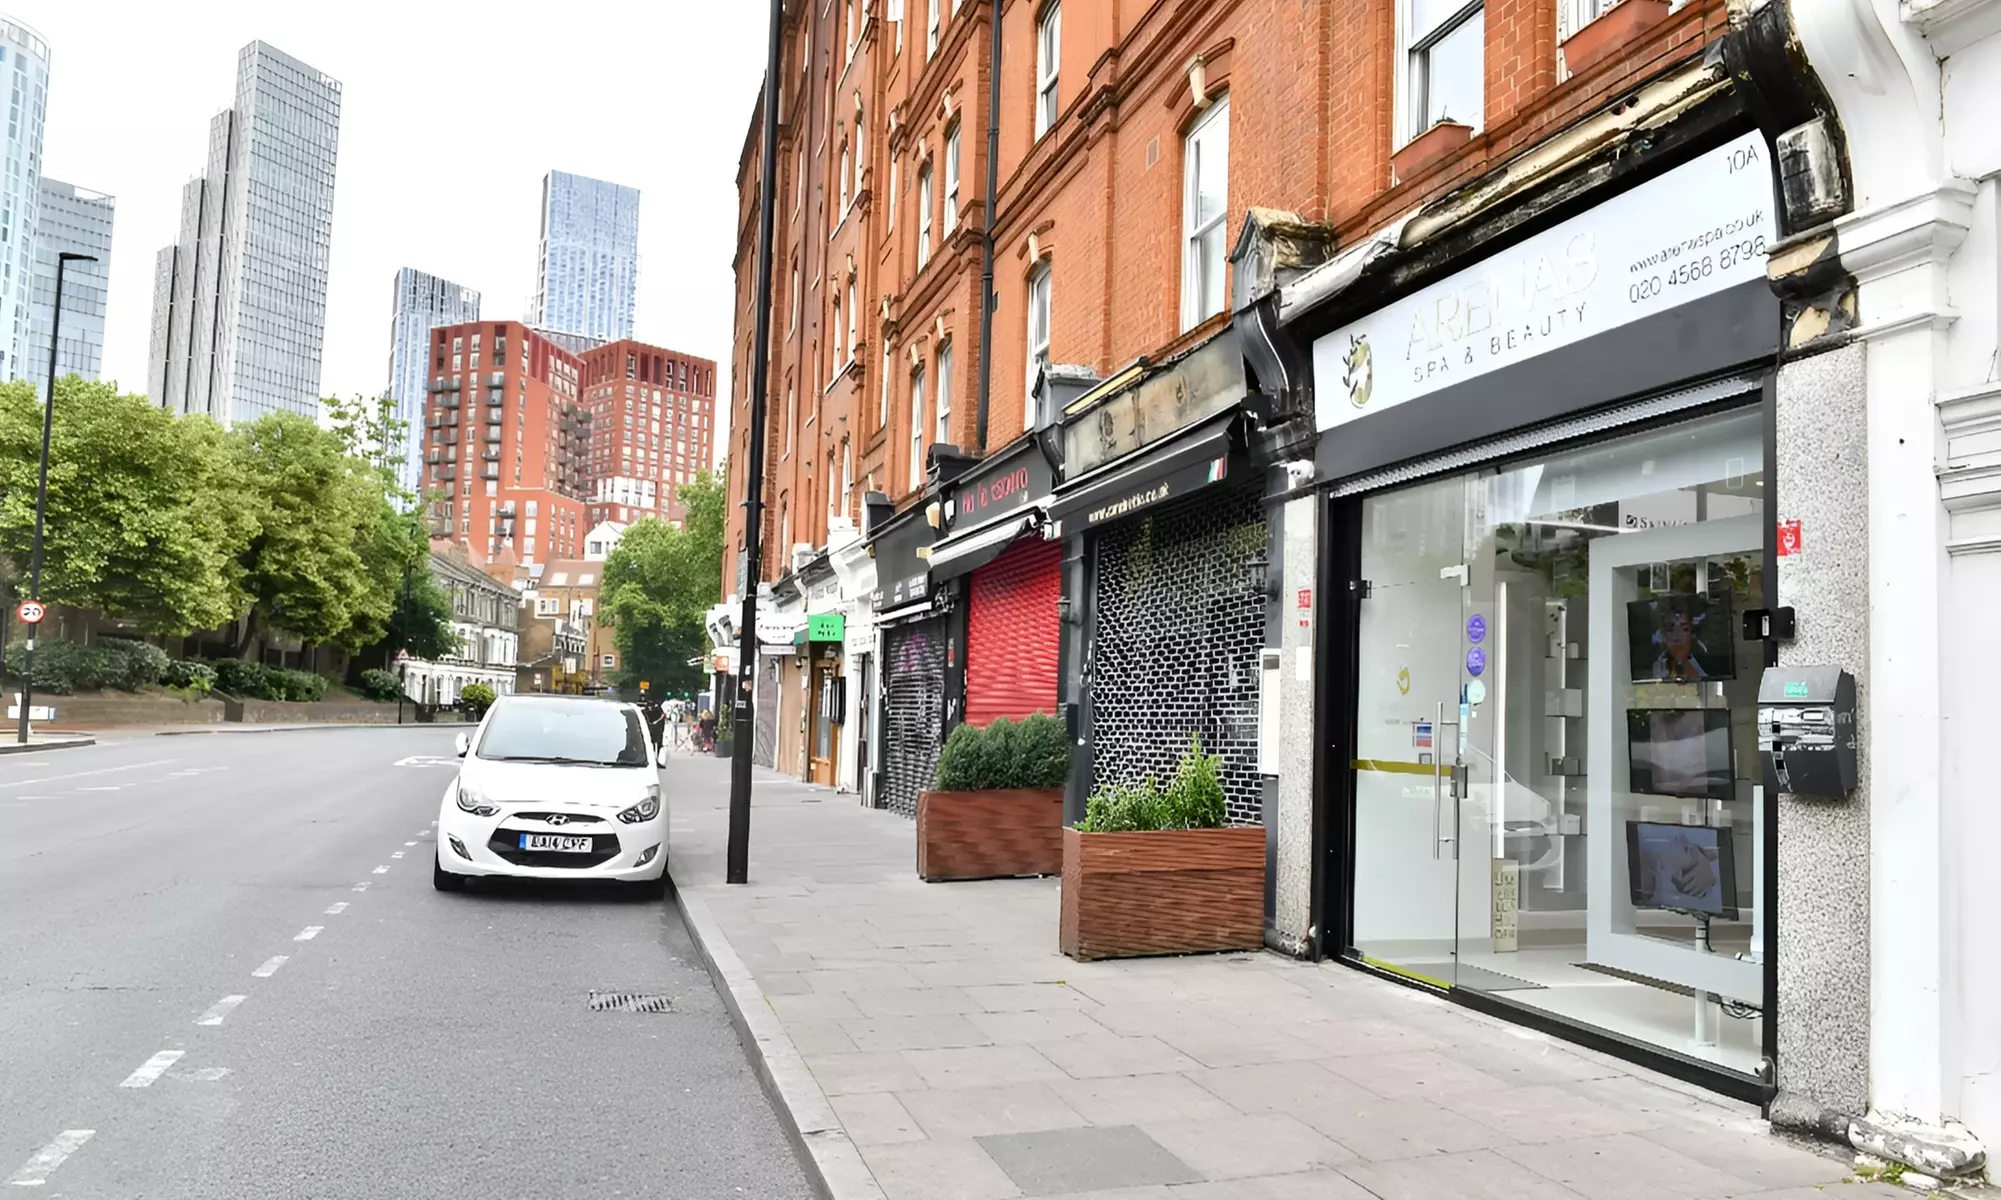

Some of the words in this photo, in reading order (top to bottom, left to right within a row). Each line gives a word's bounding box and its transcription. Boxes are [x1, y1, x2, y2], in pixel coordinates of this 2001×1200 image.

[1726, 145, 1759, 174] 10A
[1405, 232, 1600, 361] ARENAS
[1629, 275, 1662, 304] 020
[1668, 255, 1713, 286] 4568
[1719, 234, 1766, 270] 8798
[1413, 356, 1450, 383] SPA
[1463, 346, 1474, 364] &
[1489, 301, 1587, 355] BEAUTY
[23, 607, 42, 617] 20
